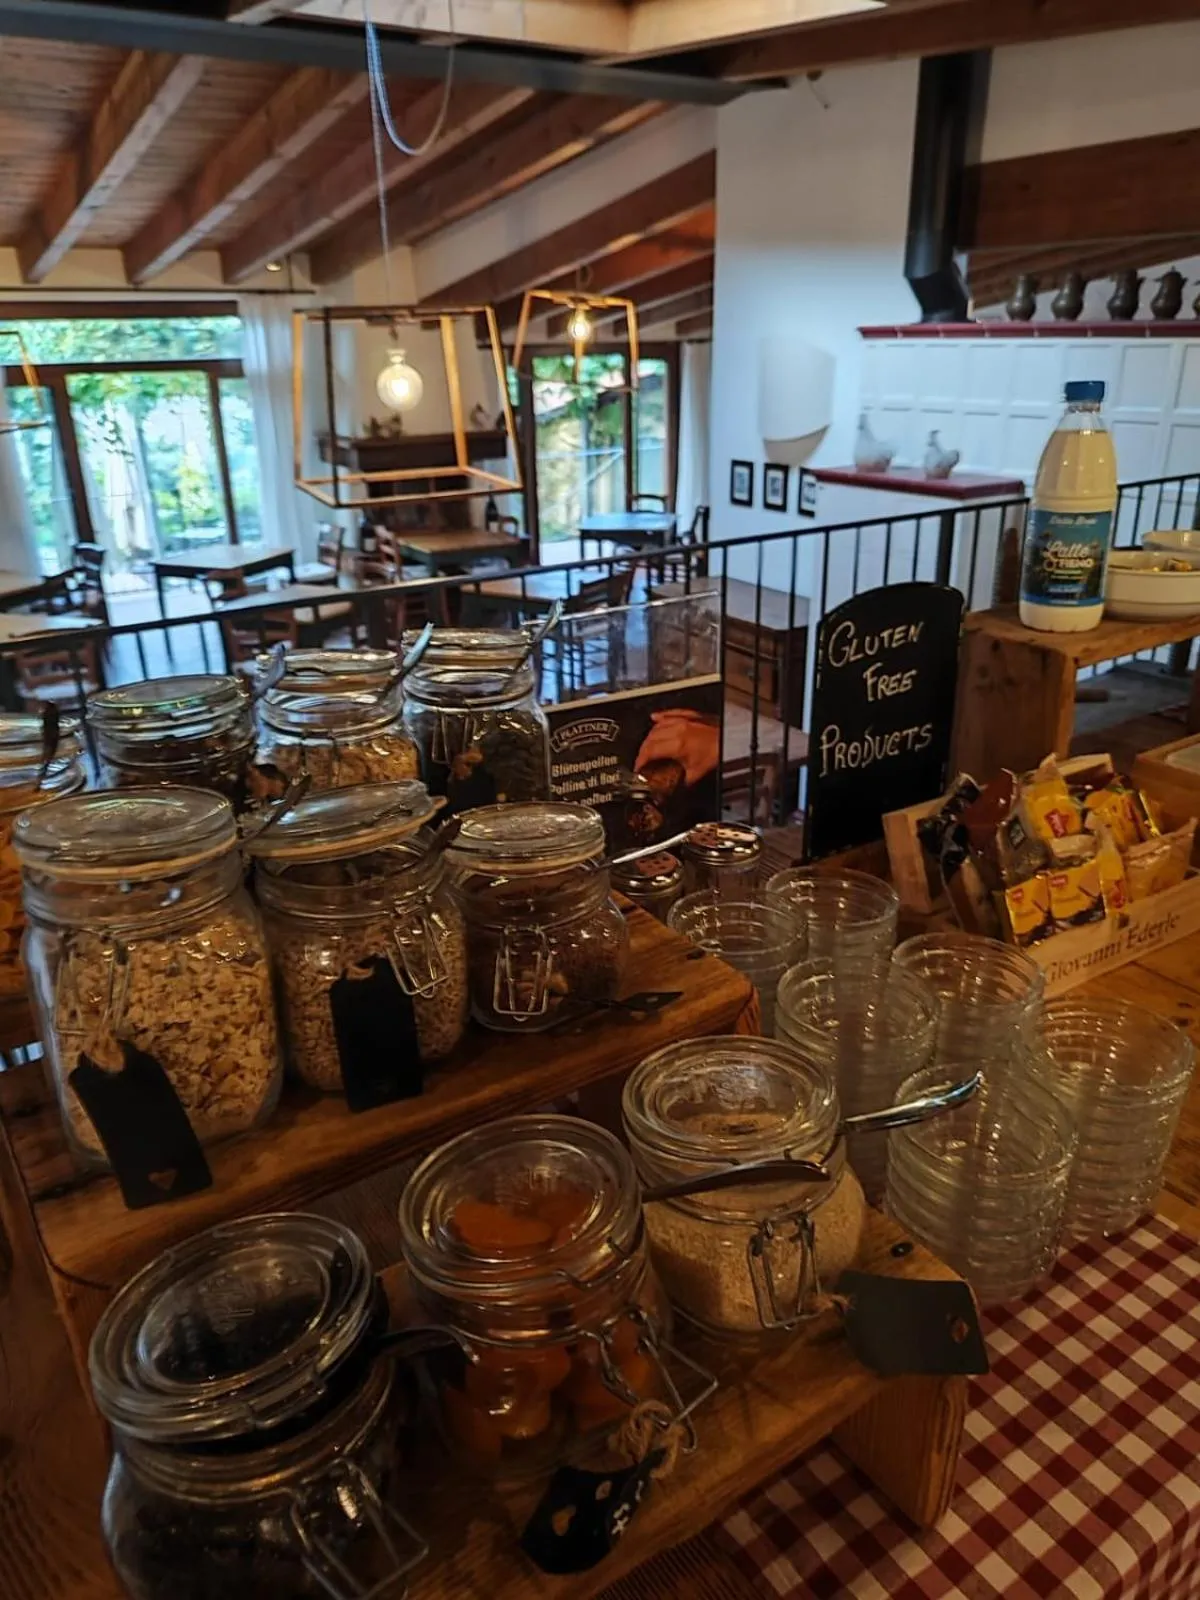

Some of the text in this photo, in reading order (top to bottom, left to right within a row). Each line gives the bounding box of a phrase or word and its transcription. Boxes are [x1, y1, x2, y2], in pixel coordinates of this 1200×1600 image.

[828, 620, 925, 667] GLUTEN
[863, 662, 918, 702] FREE
[818, 723, 933, 777] PRODUCTS
